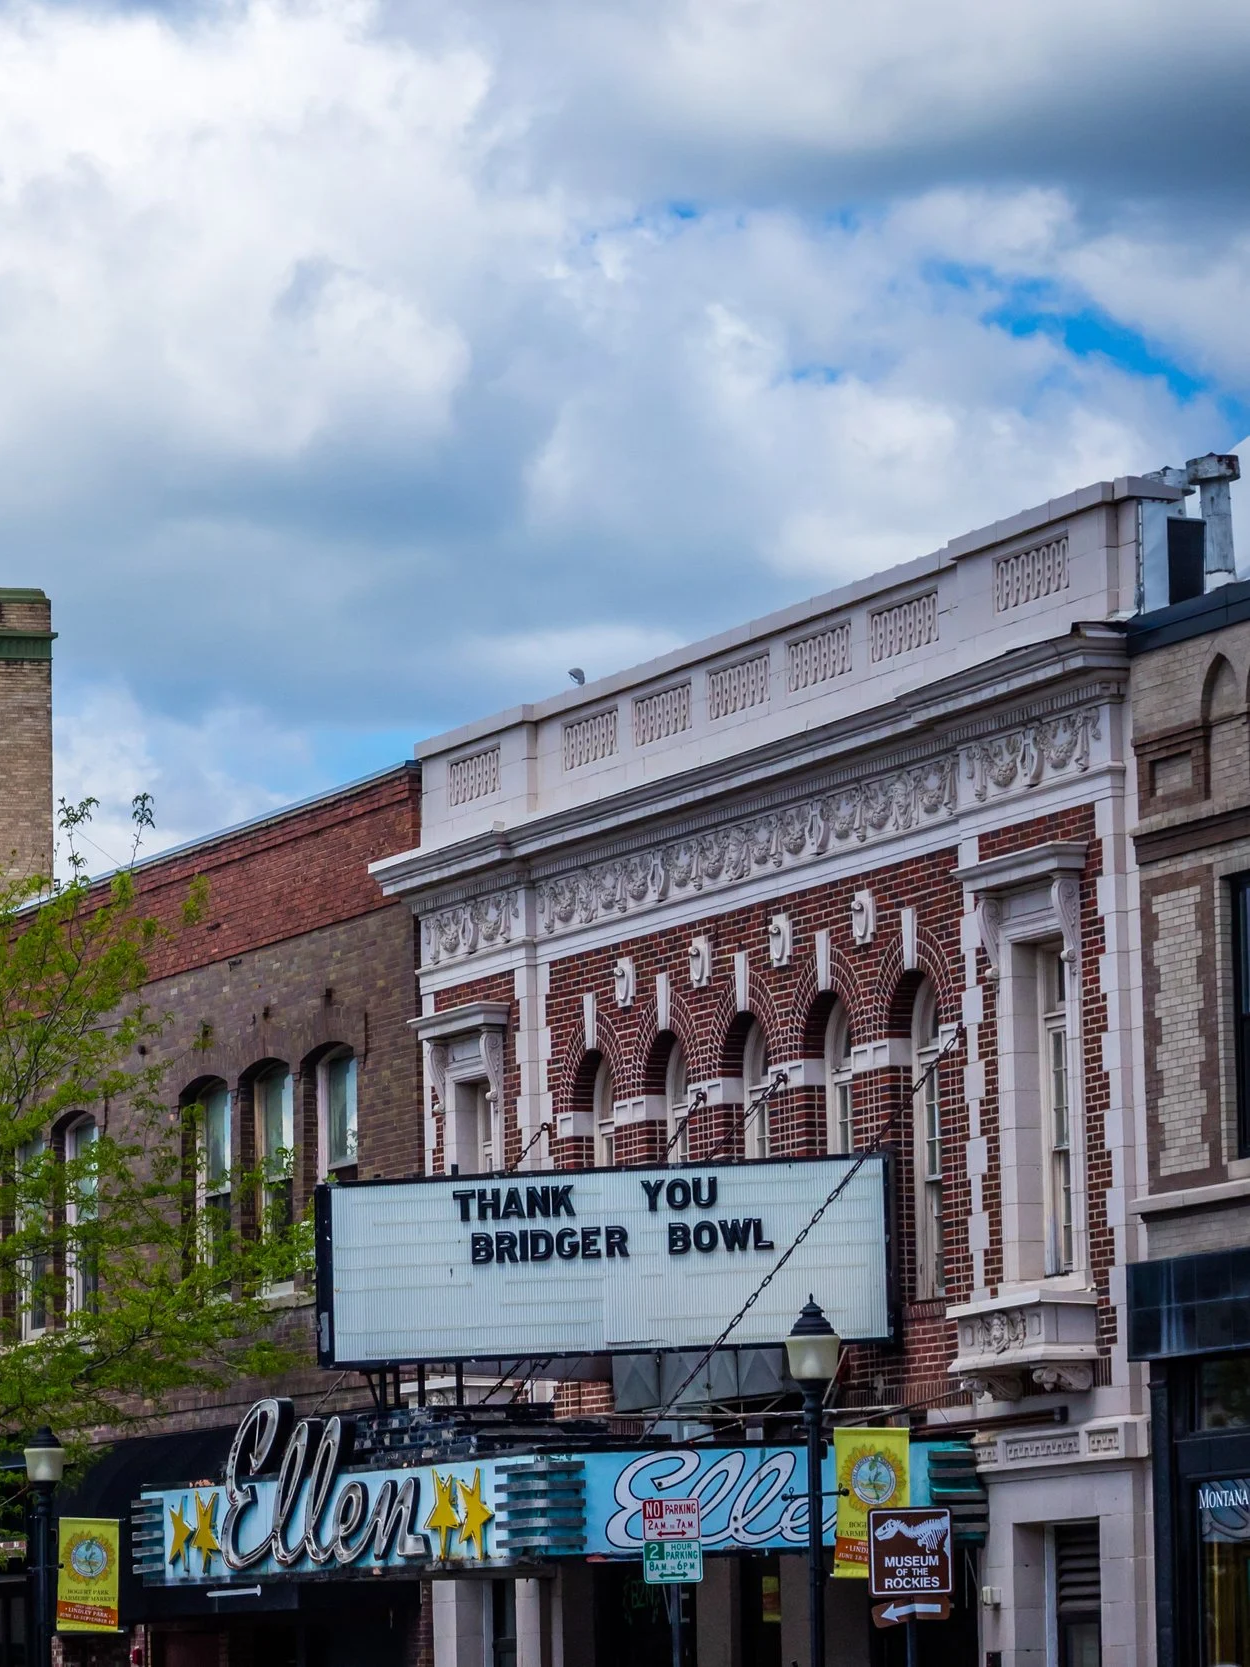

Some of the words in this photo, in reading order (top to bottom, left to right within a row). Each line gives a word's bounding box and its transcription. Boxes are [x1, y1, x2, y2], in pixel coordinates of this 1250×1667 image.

[453, 1184, 575, 1222] THANK
[641, 1176, 718, 1212] YOU
[471, 1225, 630, 1265] BRIDGER
[668, 1218, 775, 1255] BOWL
[221, 1396, 431, 1570] Ellen
[606, 1449, 838, 1550] Elle
[1198, 1488, 1249, 1509] MONTANA
[645, 1501, 661, 1518] NO
[665, 1503, 696, 1515] PARKING
[649, 1543, 659, 1559] 2
[671, 1543, 692, 1551] HOUR
[665, 1550, 698, 1560] PARKING
[884, 1555, 939, 1567] MUSEUM
[896, 1568, 908, 1576] OF
[912, 1567, 929, 1576] THE
[884, 1576, 940, 1589] ROCKIES
